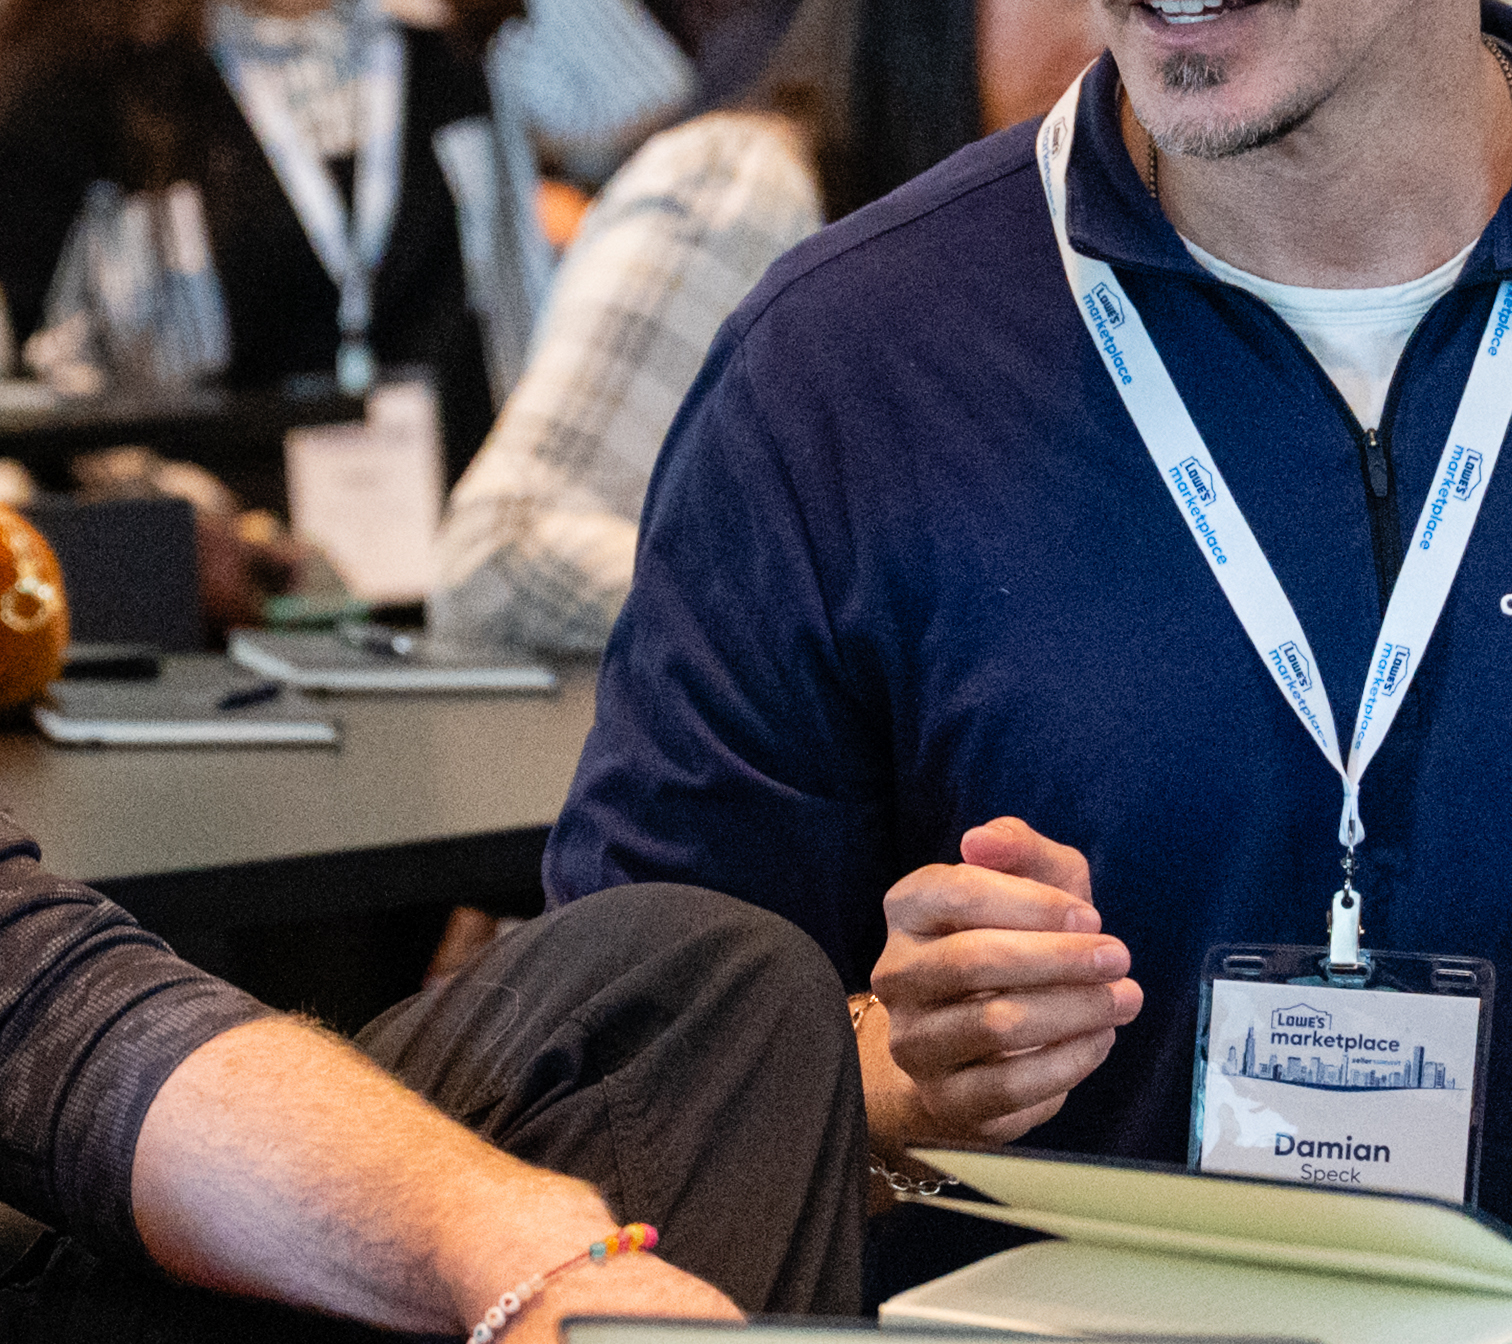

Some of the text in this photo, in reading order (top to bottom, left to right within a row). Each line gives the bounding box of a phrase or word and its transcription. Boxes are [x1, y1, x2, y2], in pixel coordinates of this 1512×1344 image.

[1083, 293, 1132, 385] marketplace
[1169, 466, 1227, 565] marketplace
[1419, 444, 1465, 550] marketplace
[1268, 648, 1328, 748] marketplace
[1354, 642, 1394, 750] marketplace
[1270, 1030, 1400, 1052] marketplace
[1277, 1013, 1325, 1029] LOWE'S
[1274, 1131, 1391, 1163] Damian
[1300, 1163, 1362, 1184] Speck
